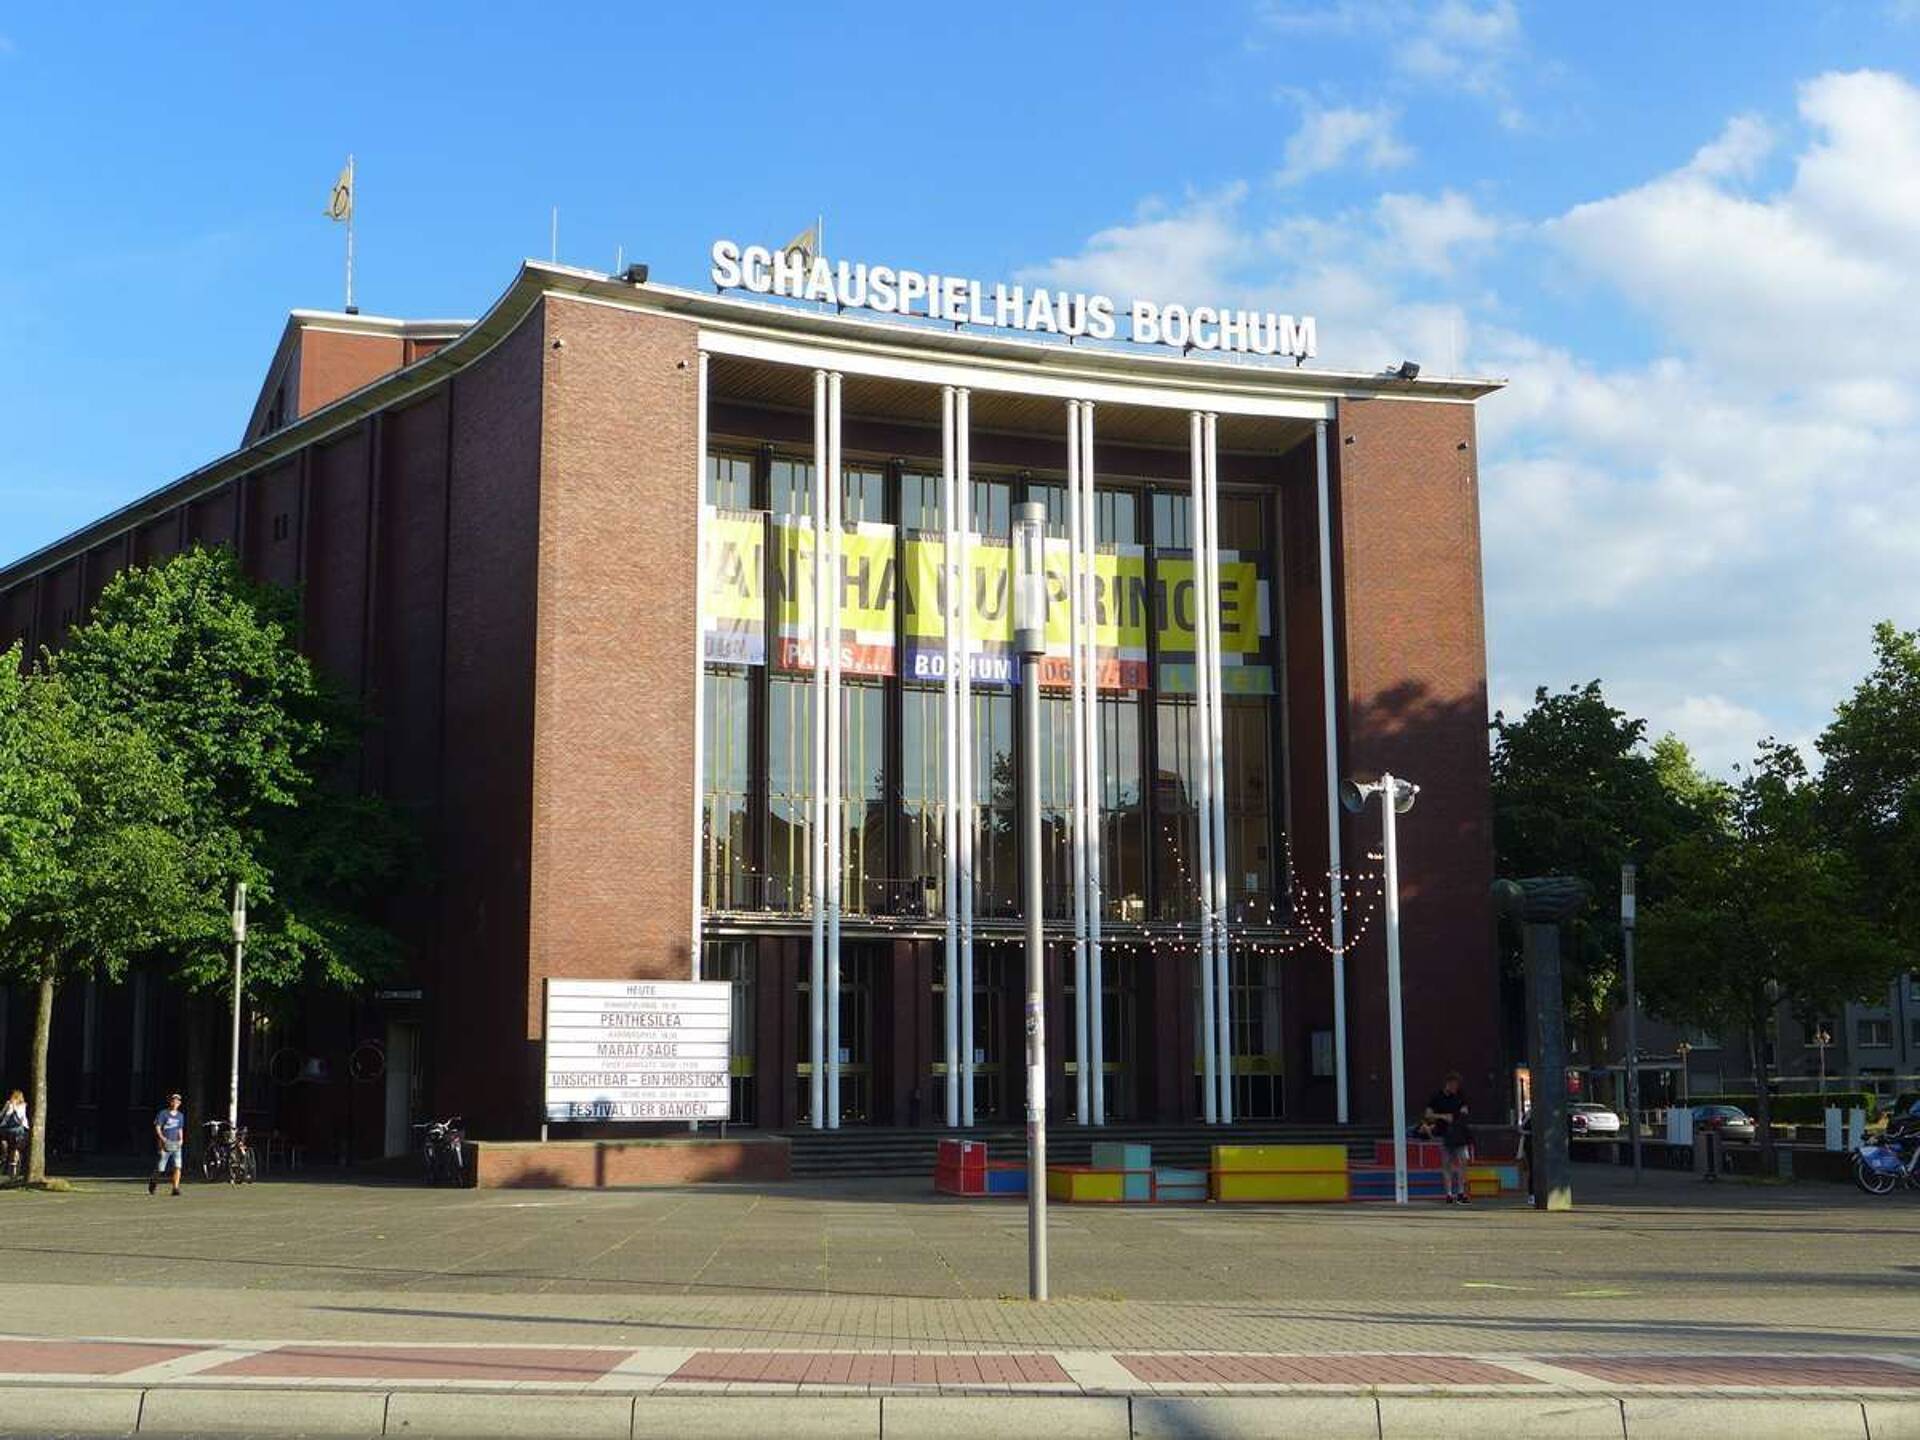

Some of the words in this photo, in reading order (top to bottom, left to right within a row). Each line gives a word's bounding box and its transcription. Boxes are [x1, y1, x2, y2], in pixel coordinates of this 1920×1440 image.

[711, 240, 1115, 340] SCHAUSPIELHAUS
[1131, 299, 1317, 358] BOCHUM
[626, 985, 656, 996] HEUTE
[601, 1014, 681, 1027] PENTHESILEA
[597, 1043, 678, 1057] MARAT/SADE
[552, 1074, 628, 1086] UNSICHTBAR
[641, 1074, 660, 1086] EIN
[569, 1103, 625, 1116] FESTIVAL
[631, 1103, 656, 1116] DER
[659, 1103, 708, 1116] BANDEN
